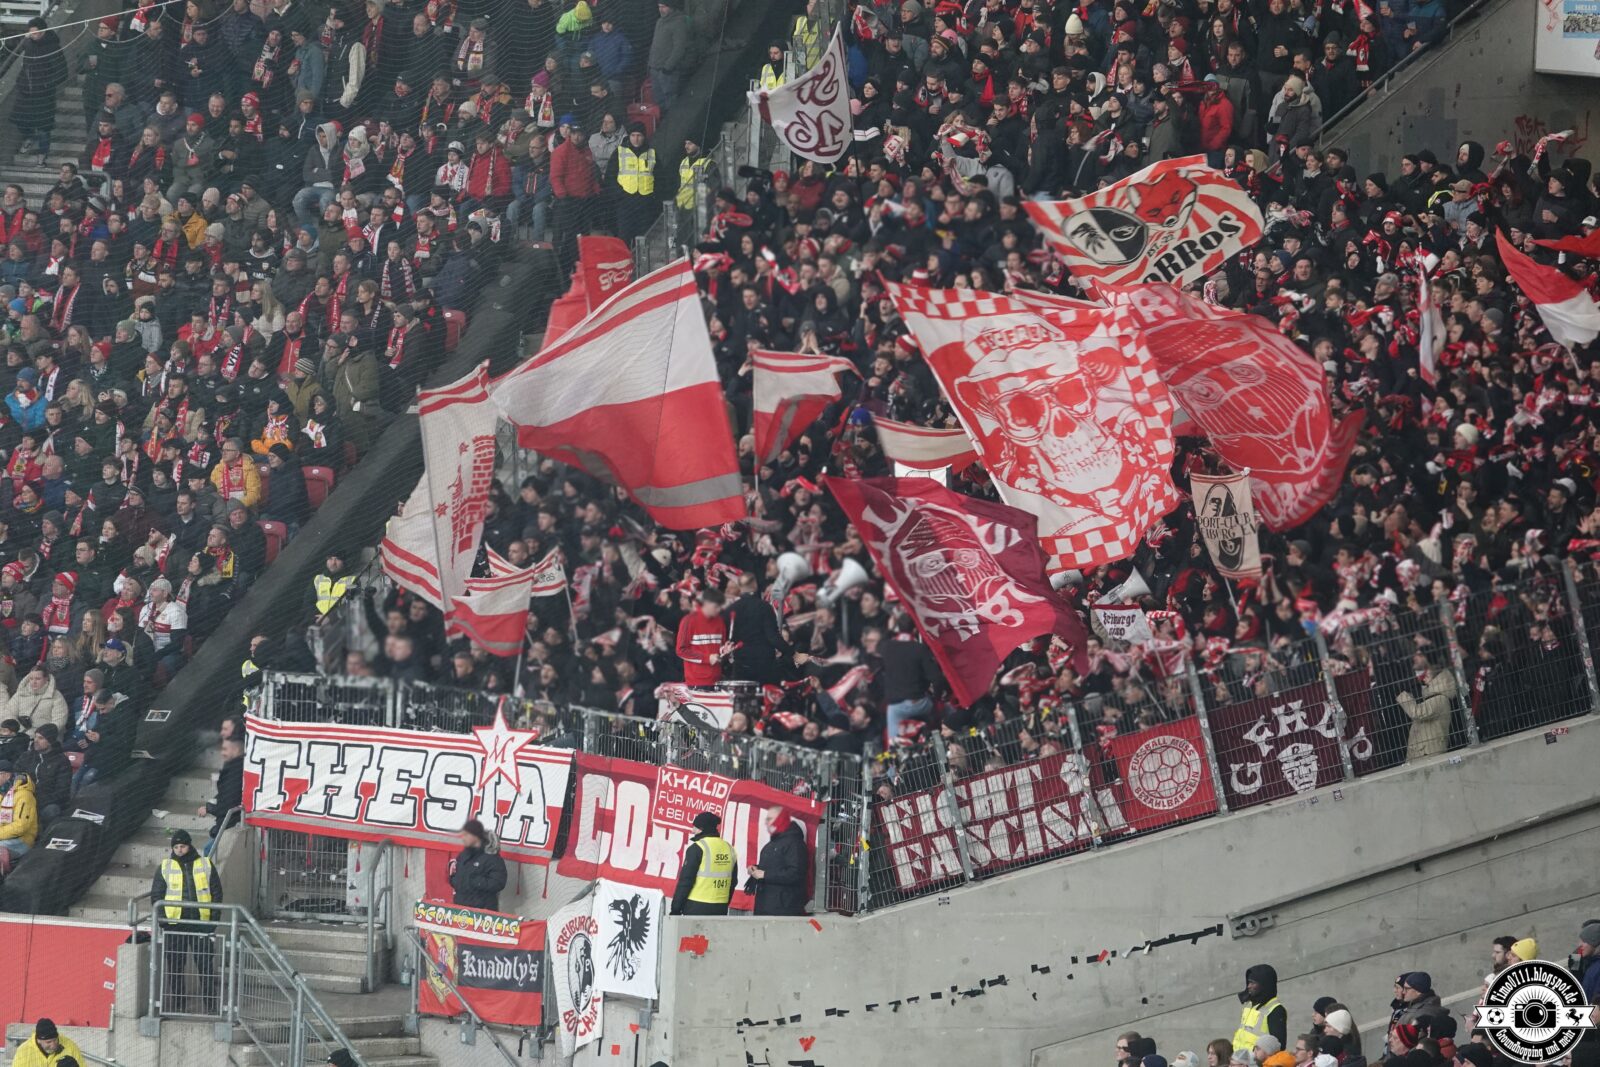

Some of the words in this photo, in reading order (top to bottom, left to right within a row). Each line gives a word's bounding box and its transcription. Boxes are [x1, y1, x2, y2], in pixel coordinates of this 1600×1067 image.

[1131, 737, 1168, 772] FUSSBALL
[246, 734, 550, 847] THESIA
[661, 769, 728, 799] KHALID
[1185, 770, 1200, 794] SEIN
[659, 789, 683, 806] FÜR
[686, 796, 722, 817] IMMER
[880, 764, 1043, 844] FIGHT
[1135, 787, 1187, 809] BEZAHLBAR
[666, 807, 684, 821] BEI
[892, 788, 1129, 889] FASCISM
[715, 853, 729, 861] SDS
[713, 879, 728, 889] 1041
[462, 950, 540, 987] Knaddly's
